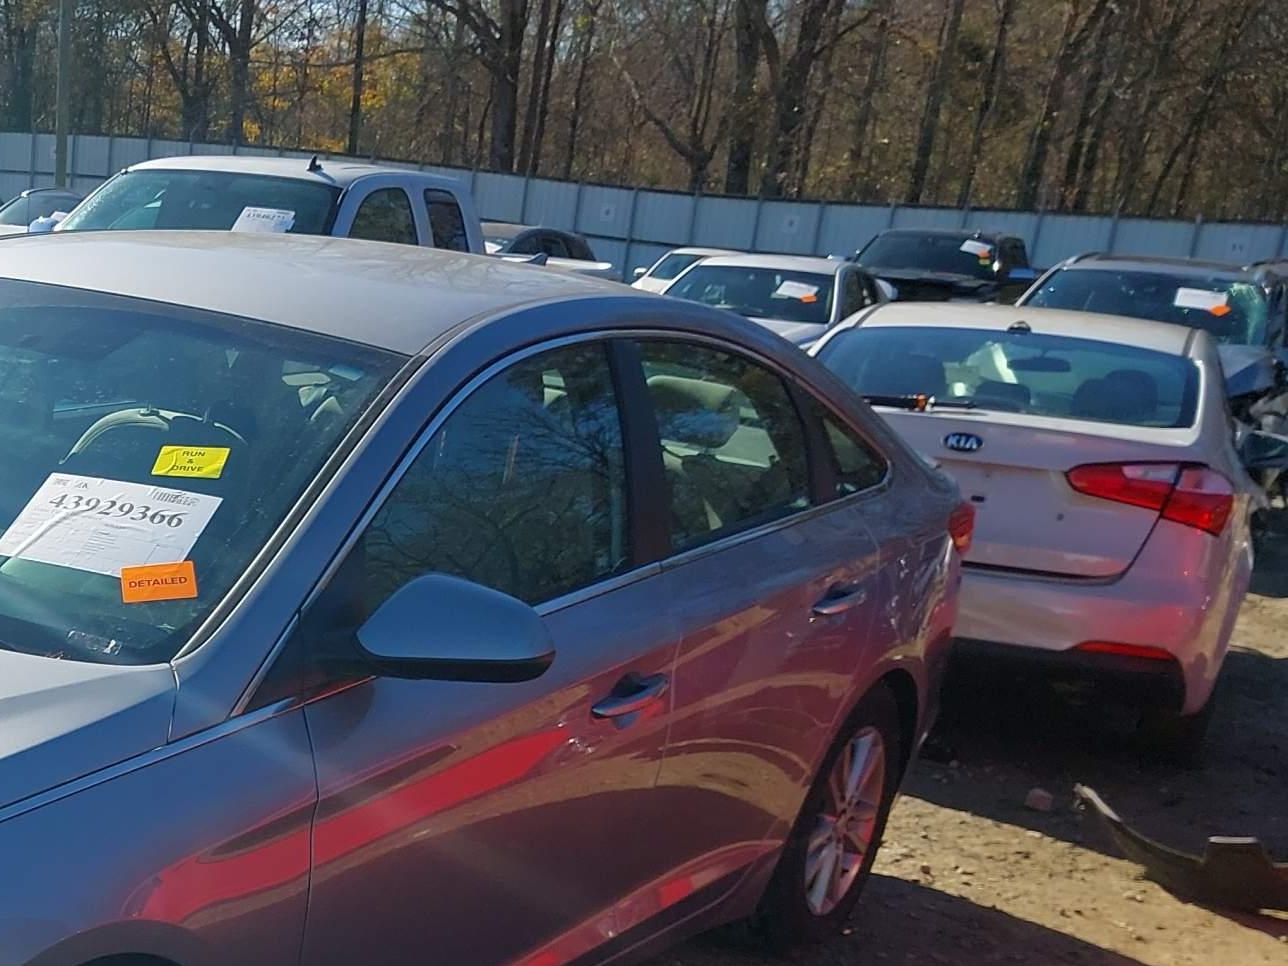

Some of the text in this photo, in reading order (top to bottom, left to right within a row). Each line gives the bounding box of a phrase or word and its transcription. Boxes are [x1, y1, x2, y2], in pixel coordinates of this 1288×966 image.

[947, 434, 978, 449] KIA
[171, 464, 204, 472] DRIVE
[49, 493, 190, 528] 43929366
[128, 576, 188, 589] DETAILED
